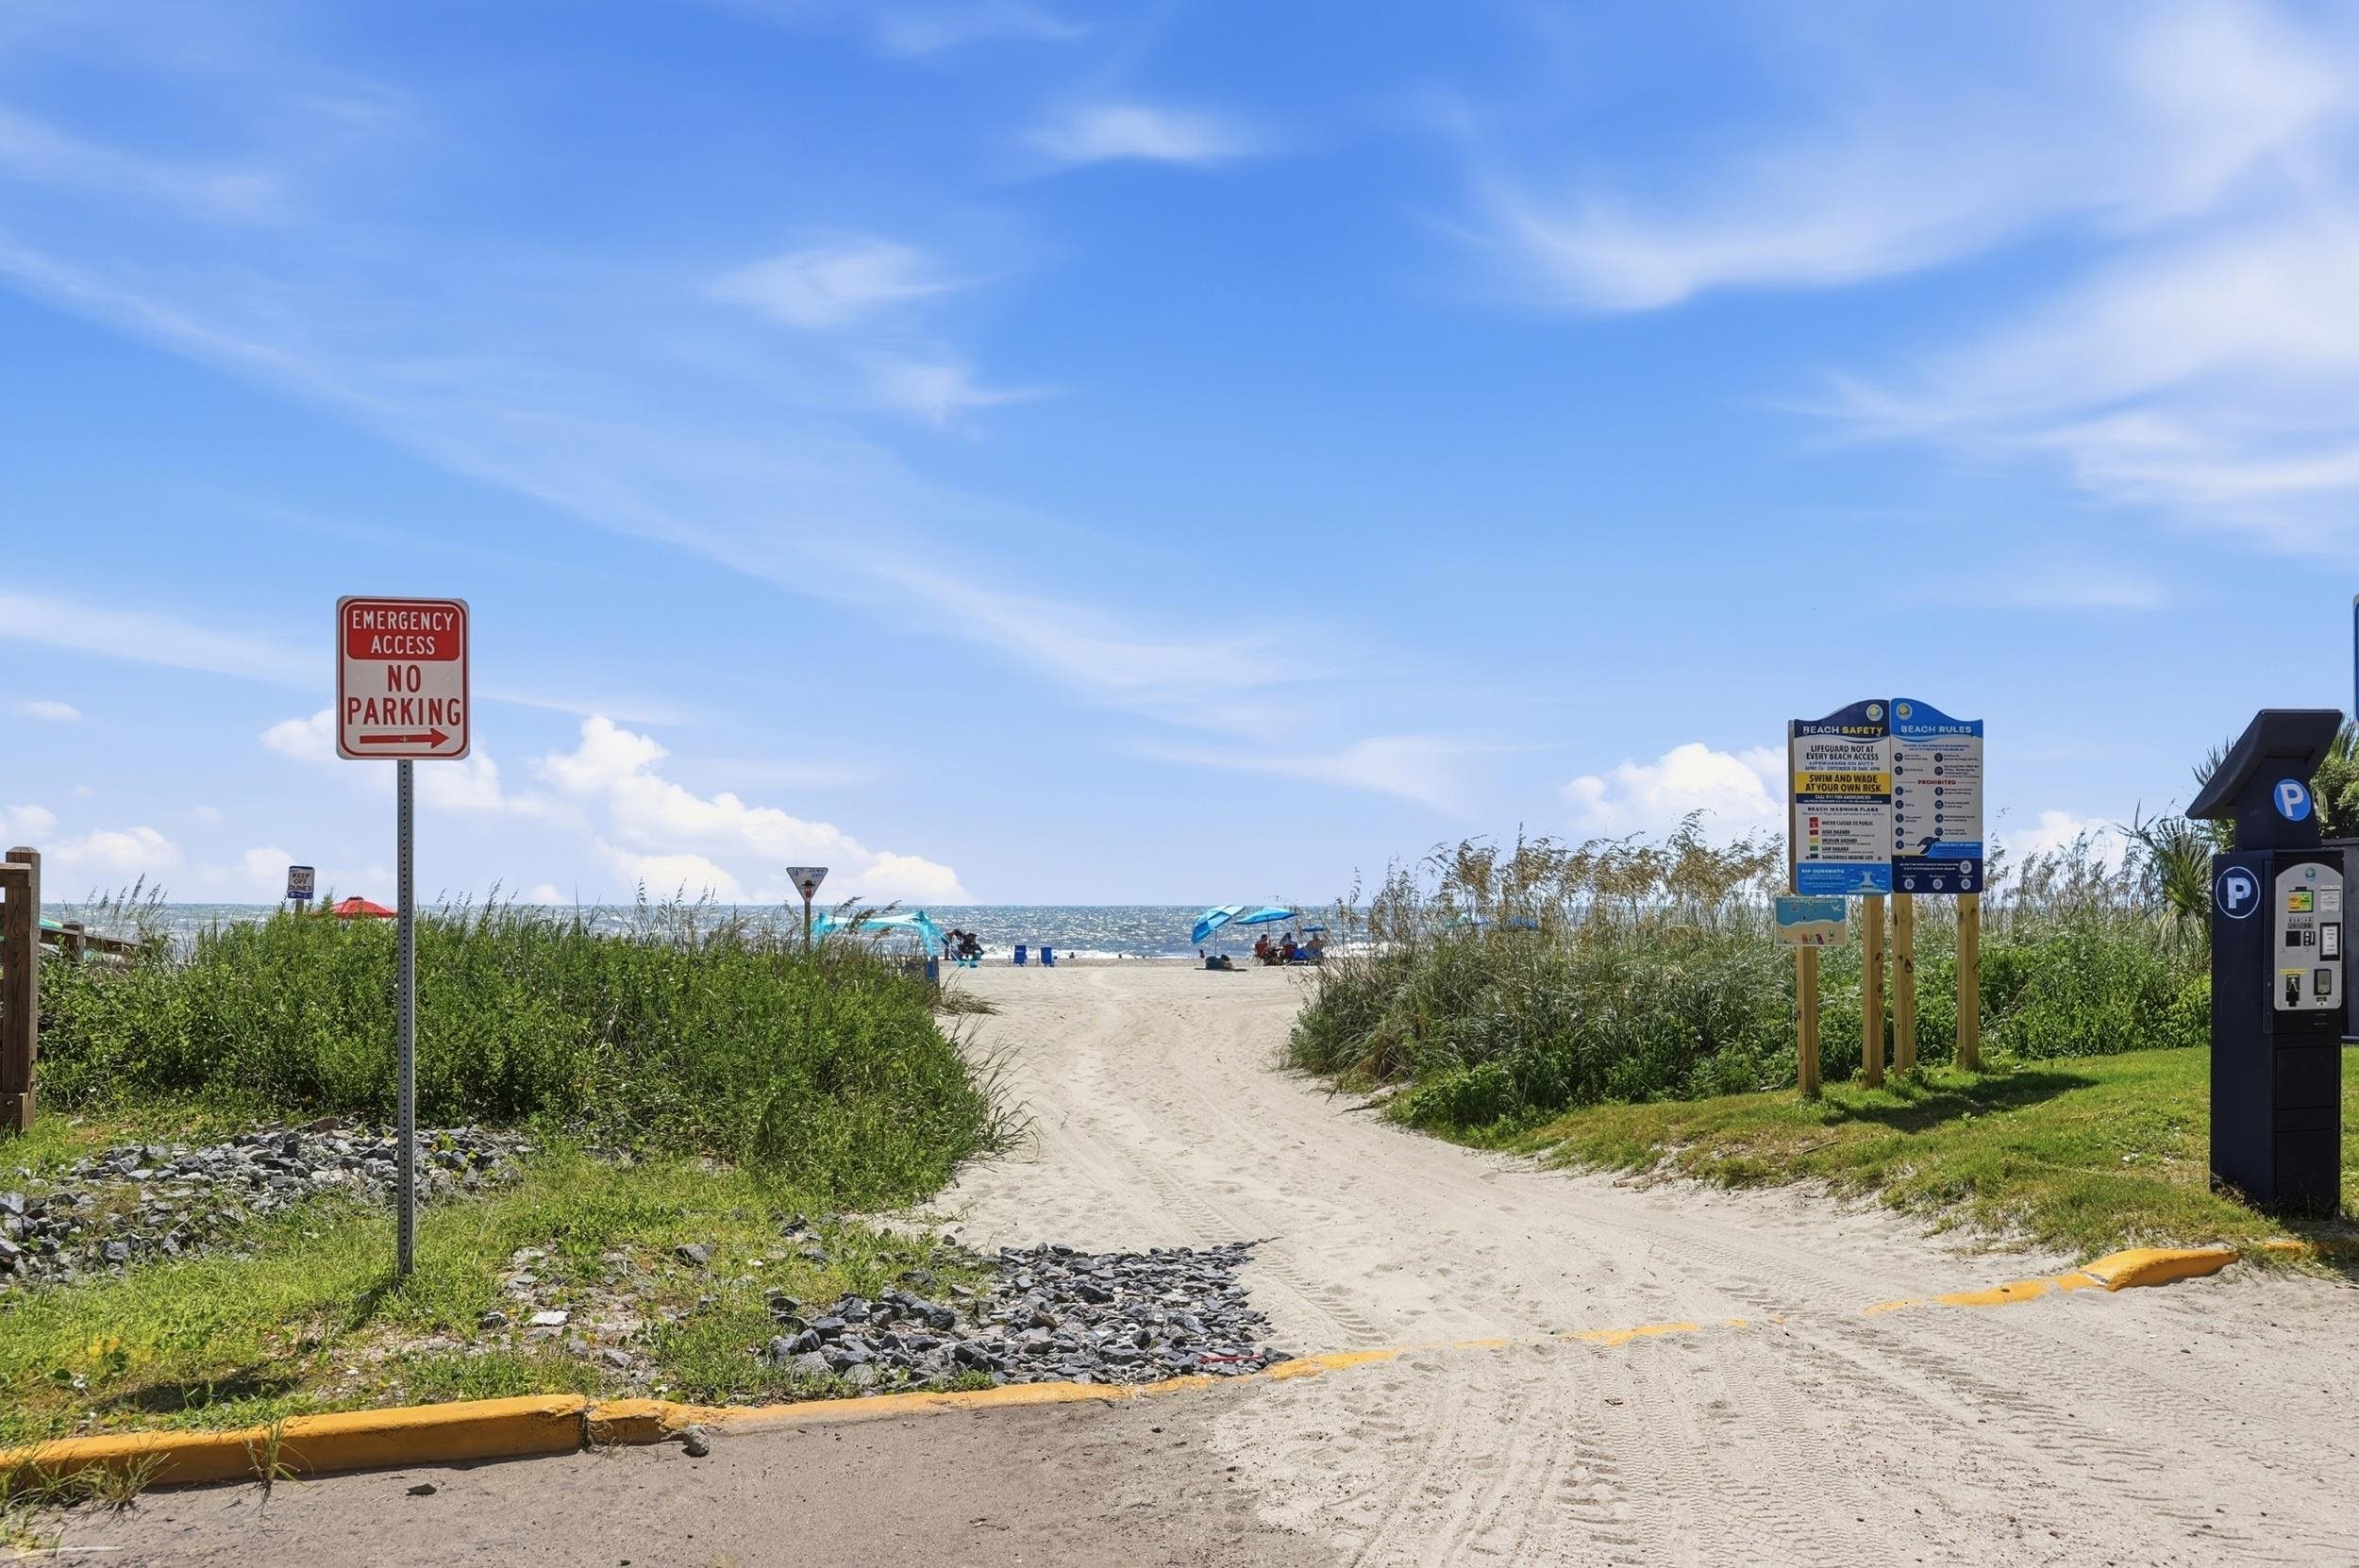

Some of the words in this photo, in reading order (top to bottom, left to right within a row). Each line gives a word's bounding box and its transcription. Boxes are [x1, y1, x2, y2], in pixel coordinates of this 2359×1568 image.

[352, 610, 454, 631] EMERGENCY
[371, 635, 436, 655] ACCESS
[387, 664, 422, 692] NO
[347, 697, 460, 726] PARKING
[1802, 726, 1840, 734] BEACH
[1842, 726, 1883, 735] SAFETY
[1806, 752, 1828, 760] EVERY
[1811, 744, 1849, 753] LIFEGUARD
[1805, 783, 1815, 792] AT
[1815, 783, 1839, 792] YOUR
[1840, 784, 1861, 792] OWN
[1863, 784, 1882, 792] RISK
[1809, 774, 1832, 782] SWIM
[1834, 775, 1852, 783] AND
[1853, 775, 1878, 783] WADE
[2279, 783, 2304, 817] P
[2227, 876, 2251, 909] P
